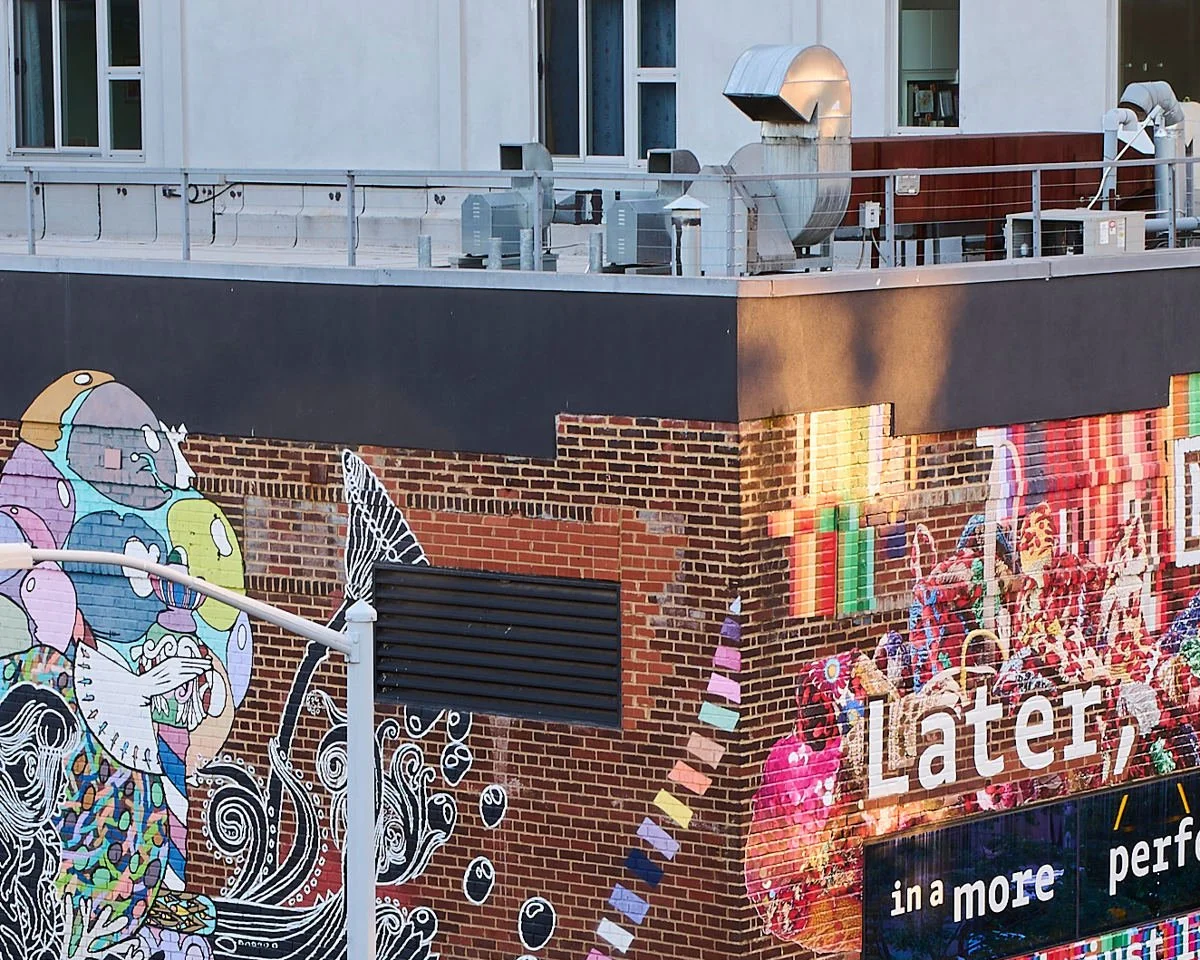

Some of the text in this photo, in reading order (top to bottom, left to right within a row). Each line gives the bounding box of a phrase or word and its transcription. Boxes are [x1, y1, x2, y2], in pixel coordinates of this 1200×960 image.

[867, 684, 1136, 800] Later,
[890, 880, 922, 917] in
[929, 878, 945, 907] a
[953, 863, 1056, 923] more
